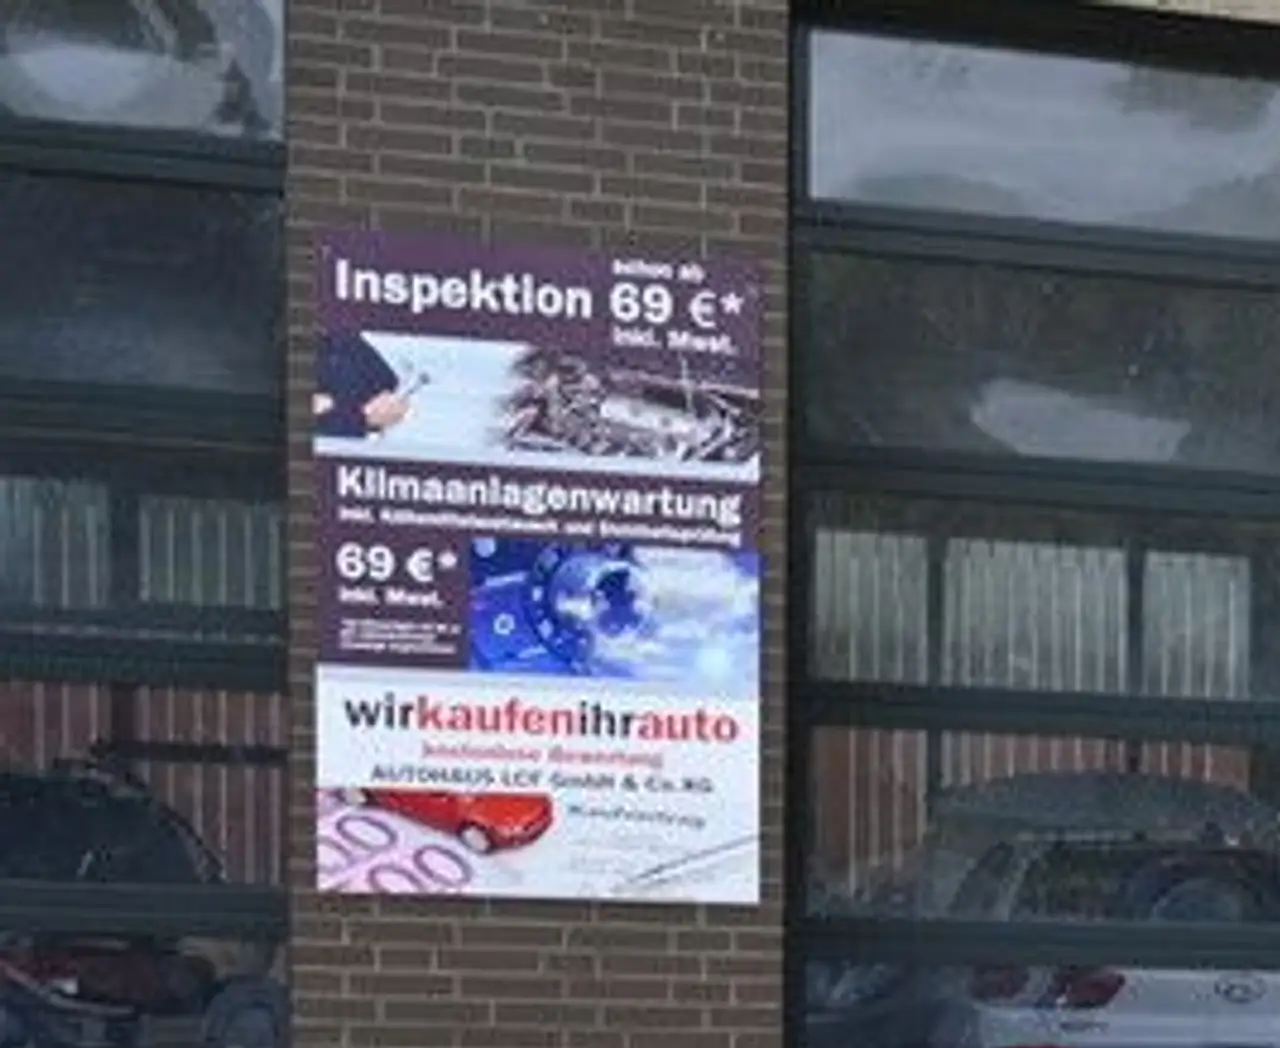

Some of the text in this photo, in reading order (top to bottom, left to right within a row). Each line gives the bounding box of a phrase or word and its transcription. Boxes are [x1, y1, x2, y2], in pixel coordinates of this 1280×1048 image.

[335, 257, 593, 320] Inspektion
[609, 281, 673, 325] 69
[337, 464, 742, 528] Klimaanlagenwartung
[336, 543, 394, 581] 69
[345, 691, 738, 743] wirkaufenihrauto
